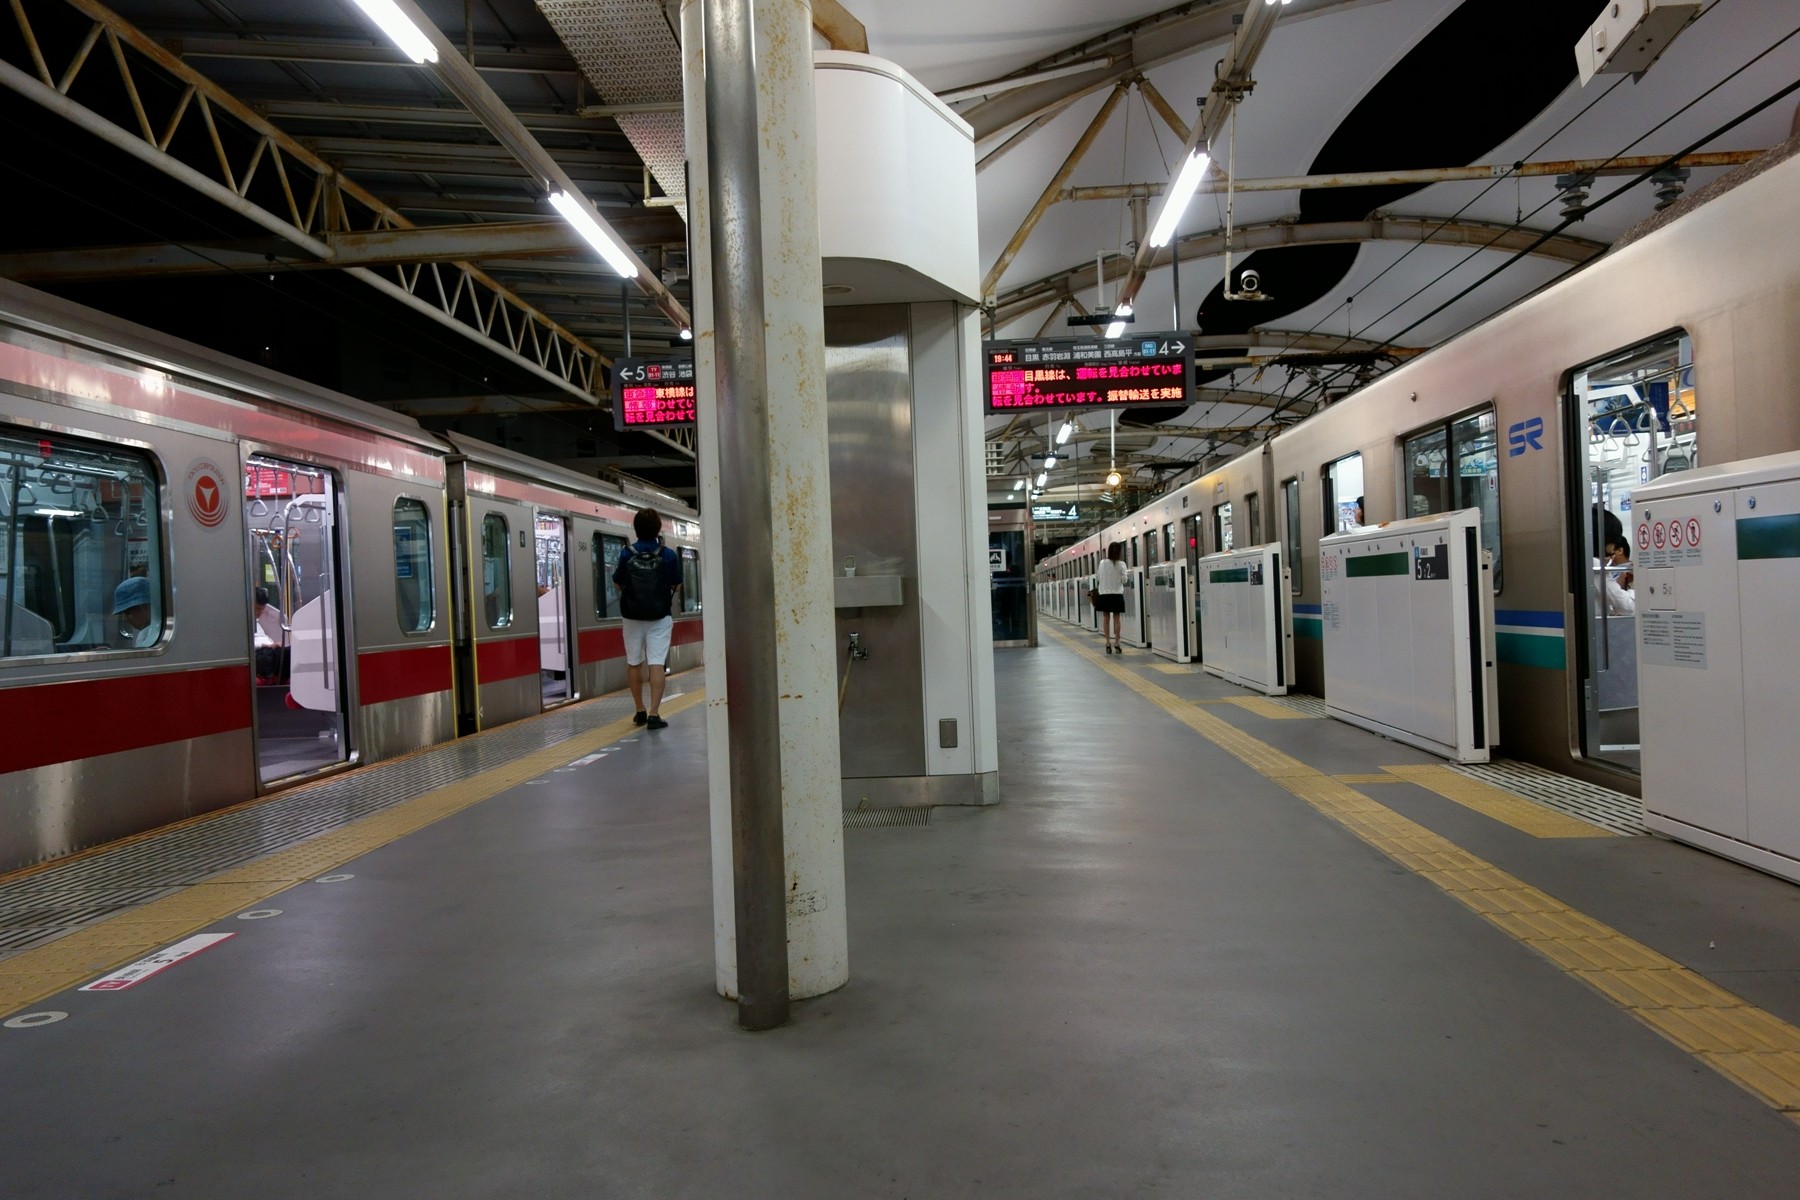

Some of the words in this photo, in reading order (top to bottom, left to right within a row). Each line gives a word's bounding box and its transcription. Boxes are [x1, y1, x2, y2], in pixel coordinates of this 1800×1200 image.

[1158, 340, 1169, 355] 4
[994, 354, 1013, 363] 19:44
[1073, 350, 1101, 359] 浦和美園
[1104, 349, 1132, 357] 西高島平
[635, 366, 645, 381] 5
[662, 370, 676, 378] 渋谷
[678, 369, 693, 378] 池袋
[655, 386, 694, 399] 東横線は
[1024, 383, 1040, 393] す。
[657, 399, 695, 410] わせてい
[1508, 416, 1543, 457] SR
[1068, 504, 1077, 516] 4
[1417, 559, 1422, 579] 5
[1426, 563, 1431, 579] 2
